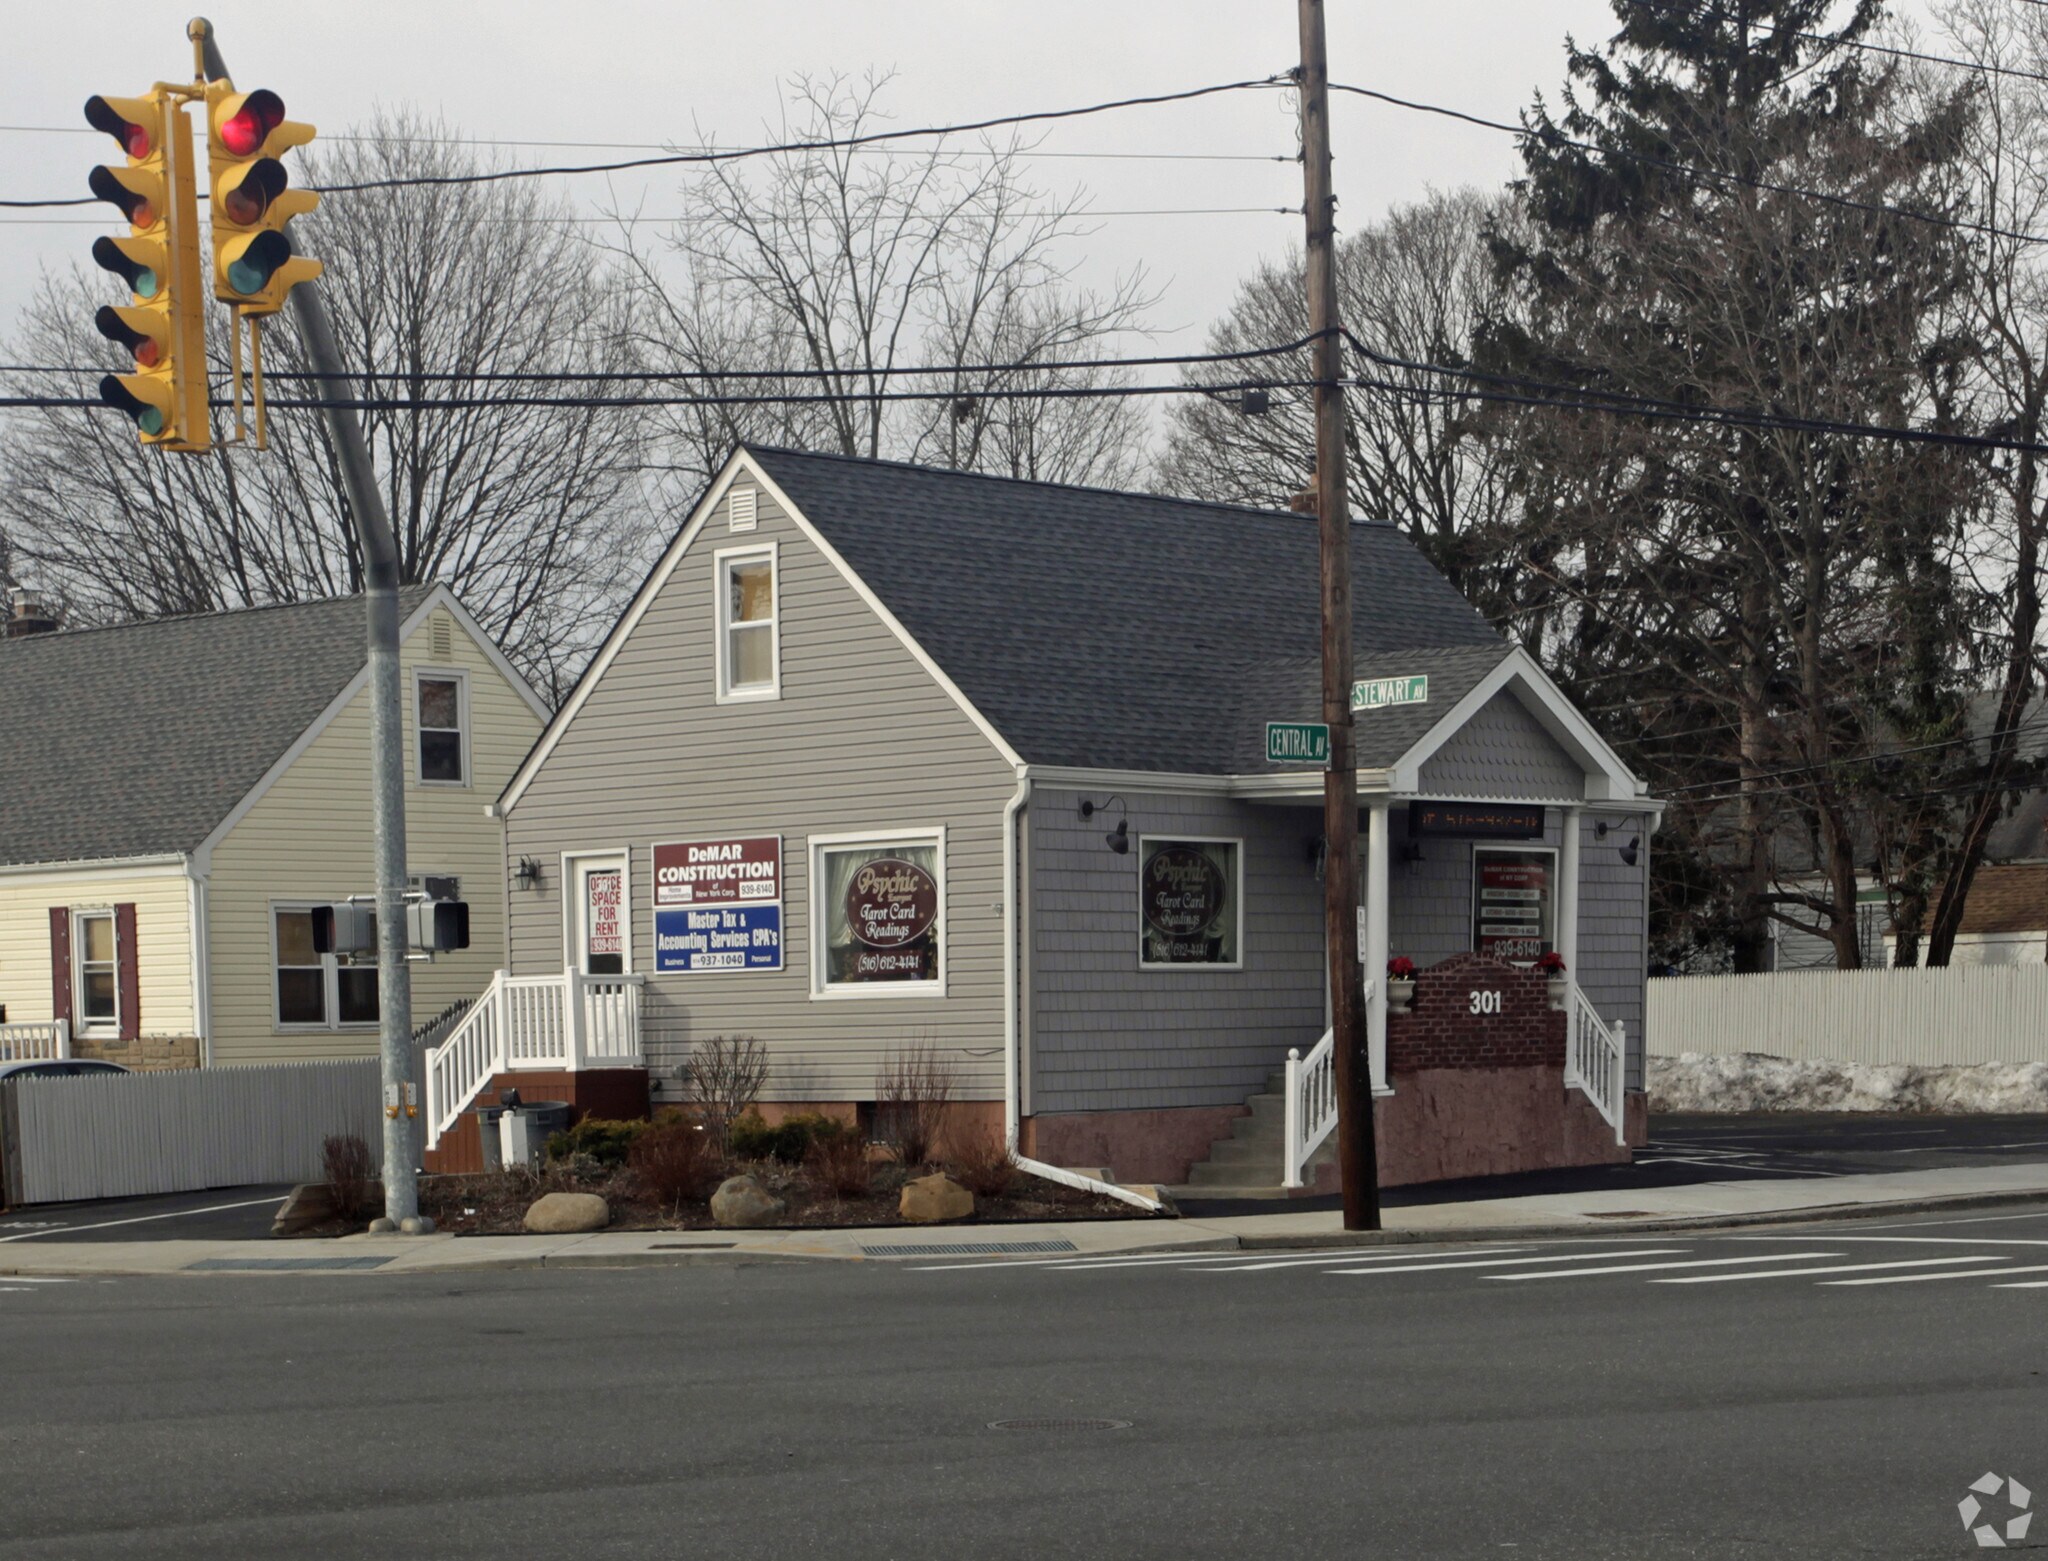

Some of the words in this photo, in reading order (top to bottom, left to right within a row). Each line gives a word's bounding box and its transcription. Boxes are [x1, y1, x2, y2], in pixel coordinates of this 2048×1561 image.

[1356, 680, 1411, 705] STEWART
[1413, 684, 1424, 699] AV
[1271, 728, 1313, 756] CENTRAL
[1315, 736, 1325, 756] AV
[688, 844, 743, 863] DeMAR
[658, 861, 775, 883] CONSTRUCTION
[695, 890, 708, 898] New
[709, 889, 720, 897] York
[721, 888, 736, 898] Corp.
[712, 882, 719, 890] of
[741, 883, 773, 895] 939-6140
[858, 867, 920, 902] Psychic
[592, 891, 621, 907] SPACE
[1156, 891, 1181, 909] Tarot
[1182, 892, 1205, 909] Card
[598, 907, 616, 921] FOR
[688, 911, 720, 930] Master
[721, 910, 736, 927] Tax
[739, 912, 746, 927] &
[860, 904, 888, 921] Tarot
[889, 903, 915, 919] Card
[1160, 909, 1200, 930] Readings
[595, 921, 619, 936] RENT
[865, 921, 909, 941] Readings
[658, 933, 707, 953] Accounting
[710, 931, 749, 948] Services
[752, 929, 778, 947] CPA's
[1494, 940, 1541, 957] 939-6140
[700, 954, 743, 966] 937-1040
[1469, 990, 1501, 1014] 301
